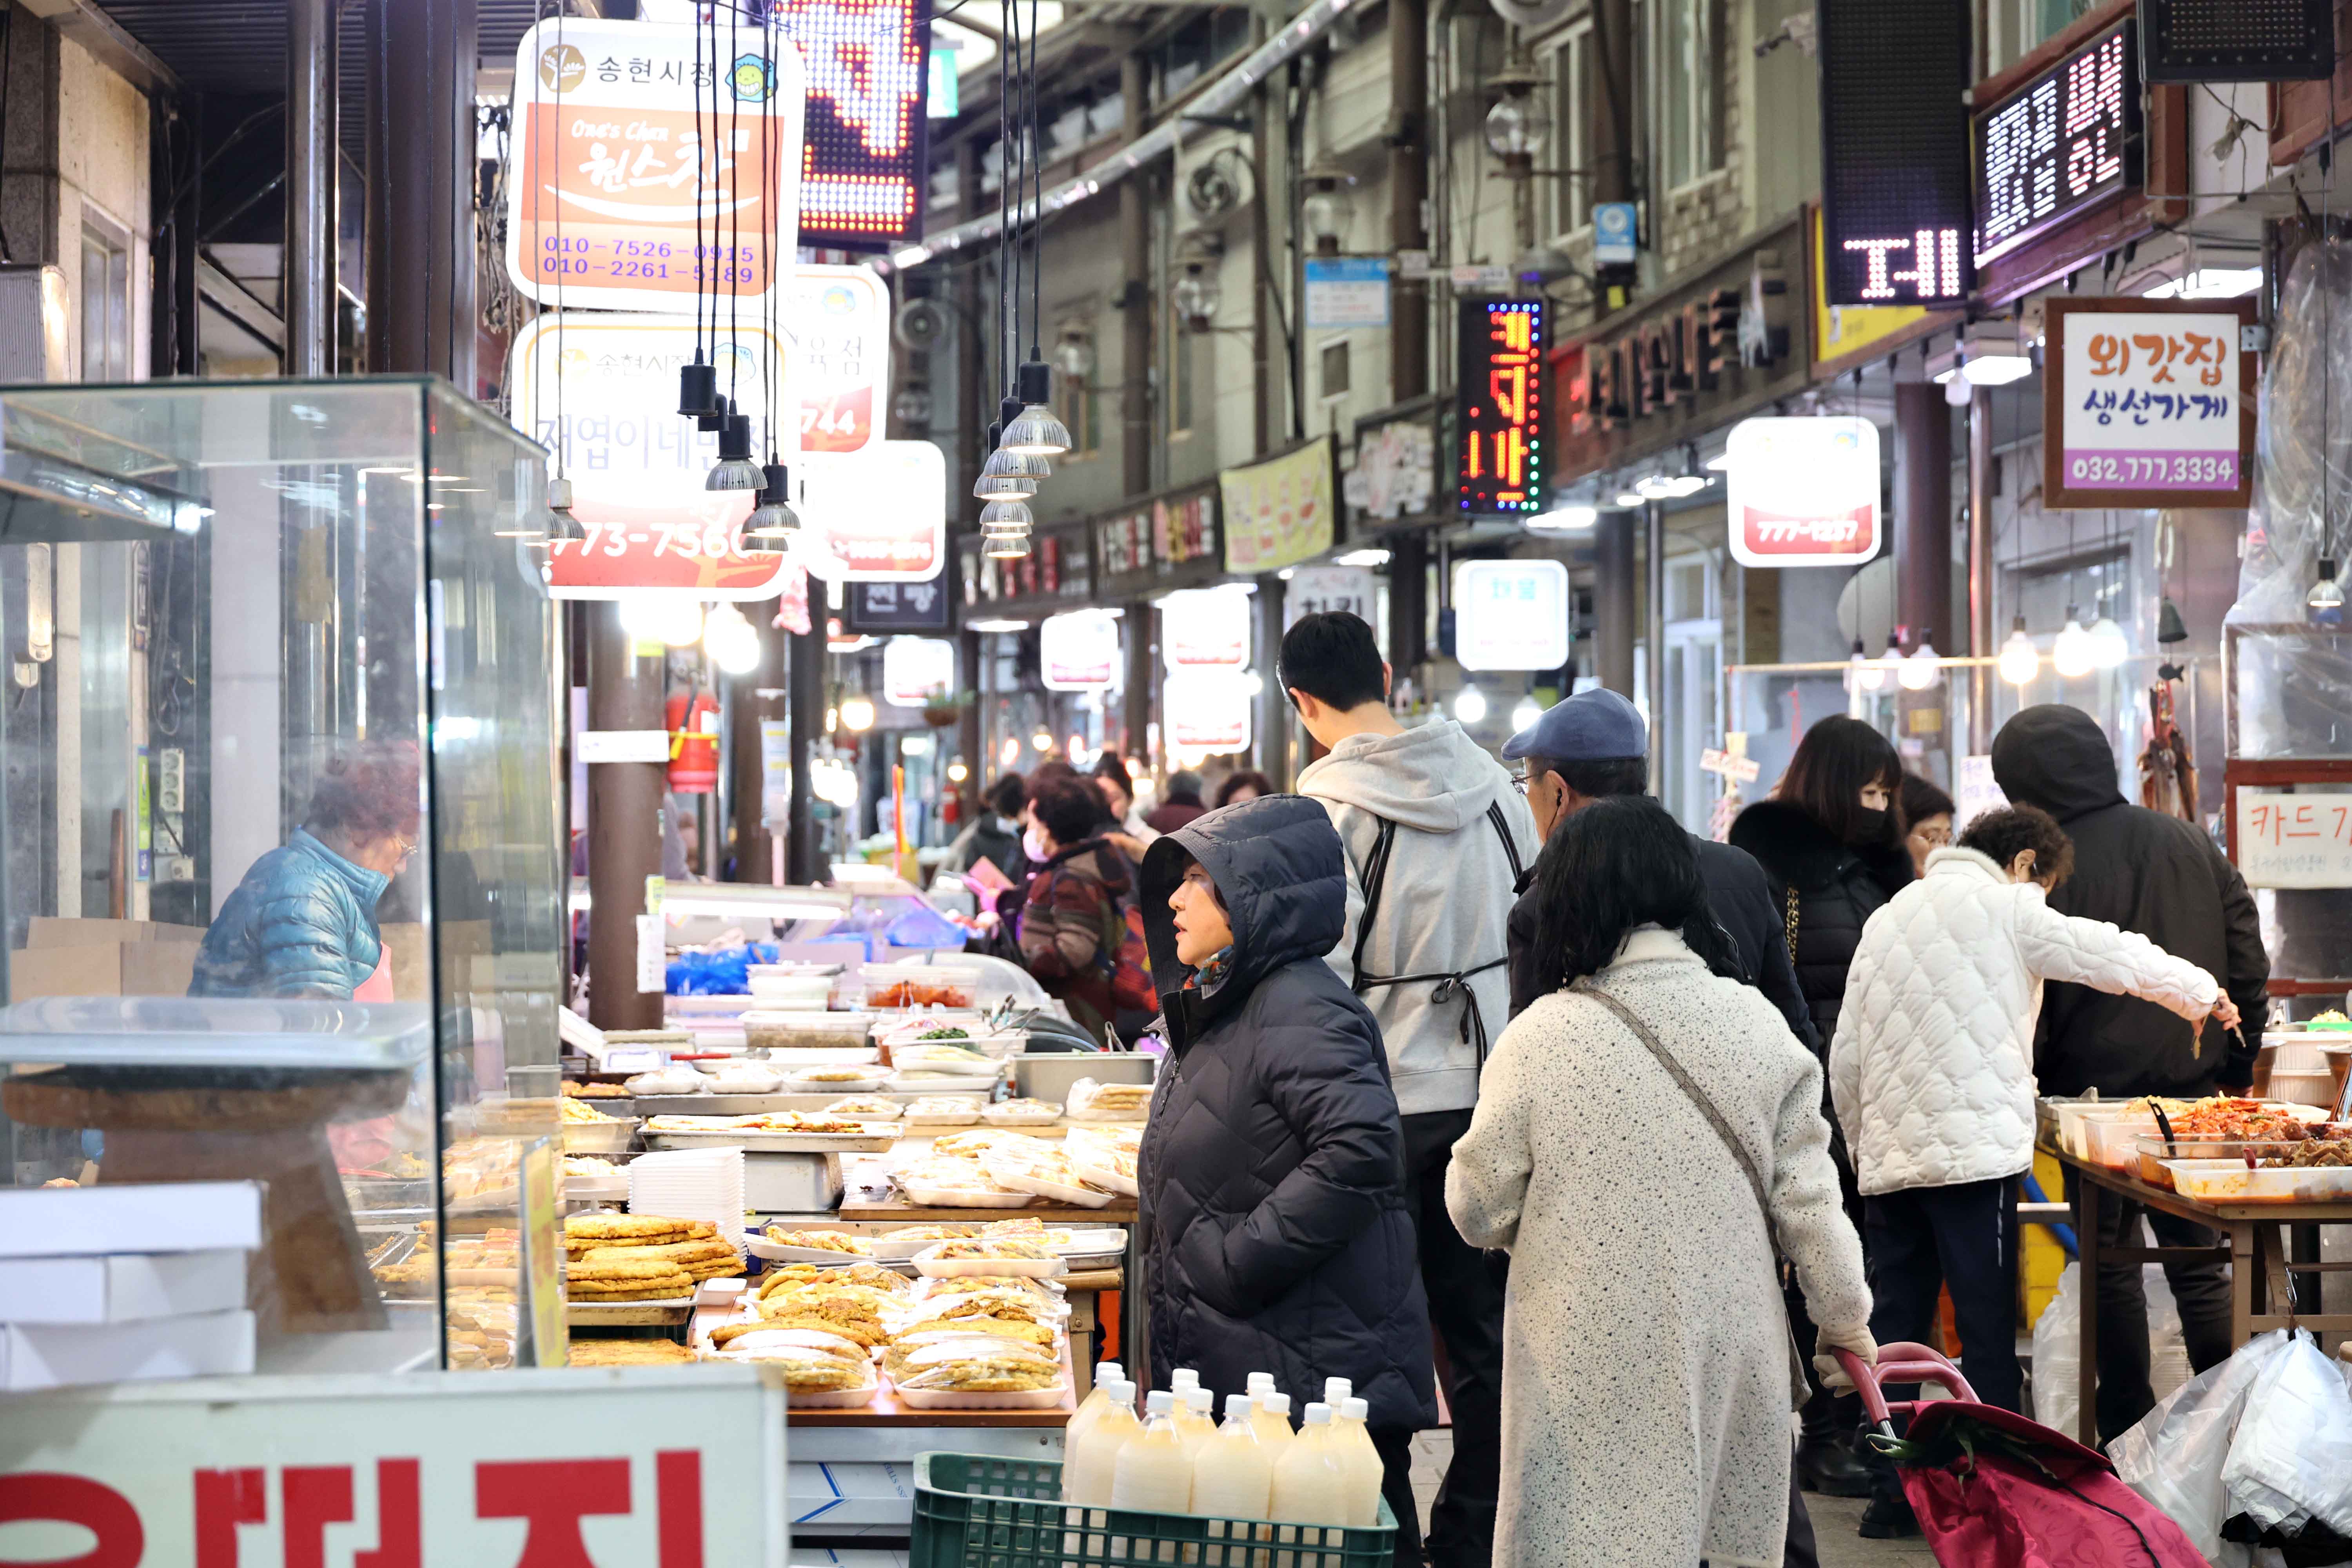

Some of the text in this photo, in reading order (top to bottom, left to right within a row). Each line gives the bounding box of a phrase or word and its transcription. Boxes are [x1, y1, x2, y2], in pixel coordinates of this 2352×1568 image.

[596, 56, 714, 88] 송현시장
[545, 236, 753, 262] 010-7526-0915
[2088, 331, 2226, 387] 외갓집
[2083, 388, 2229, 426] 생선가게
